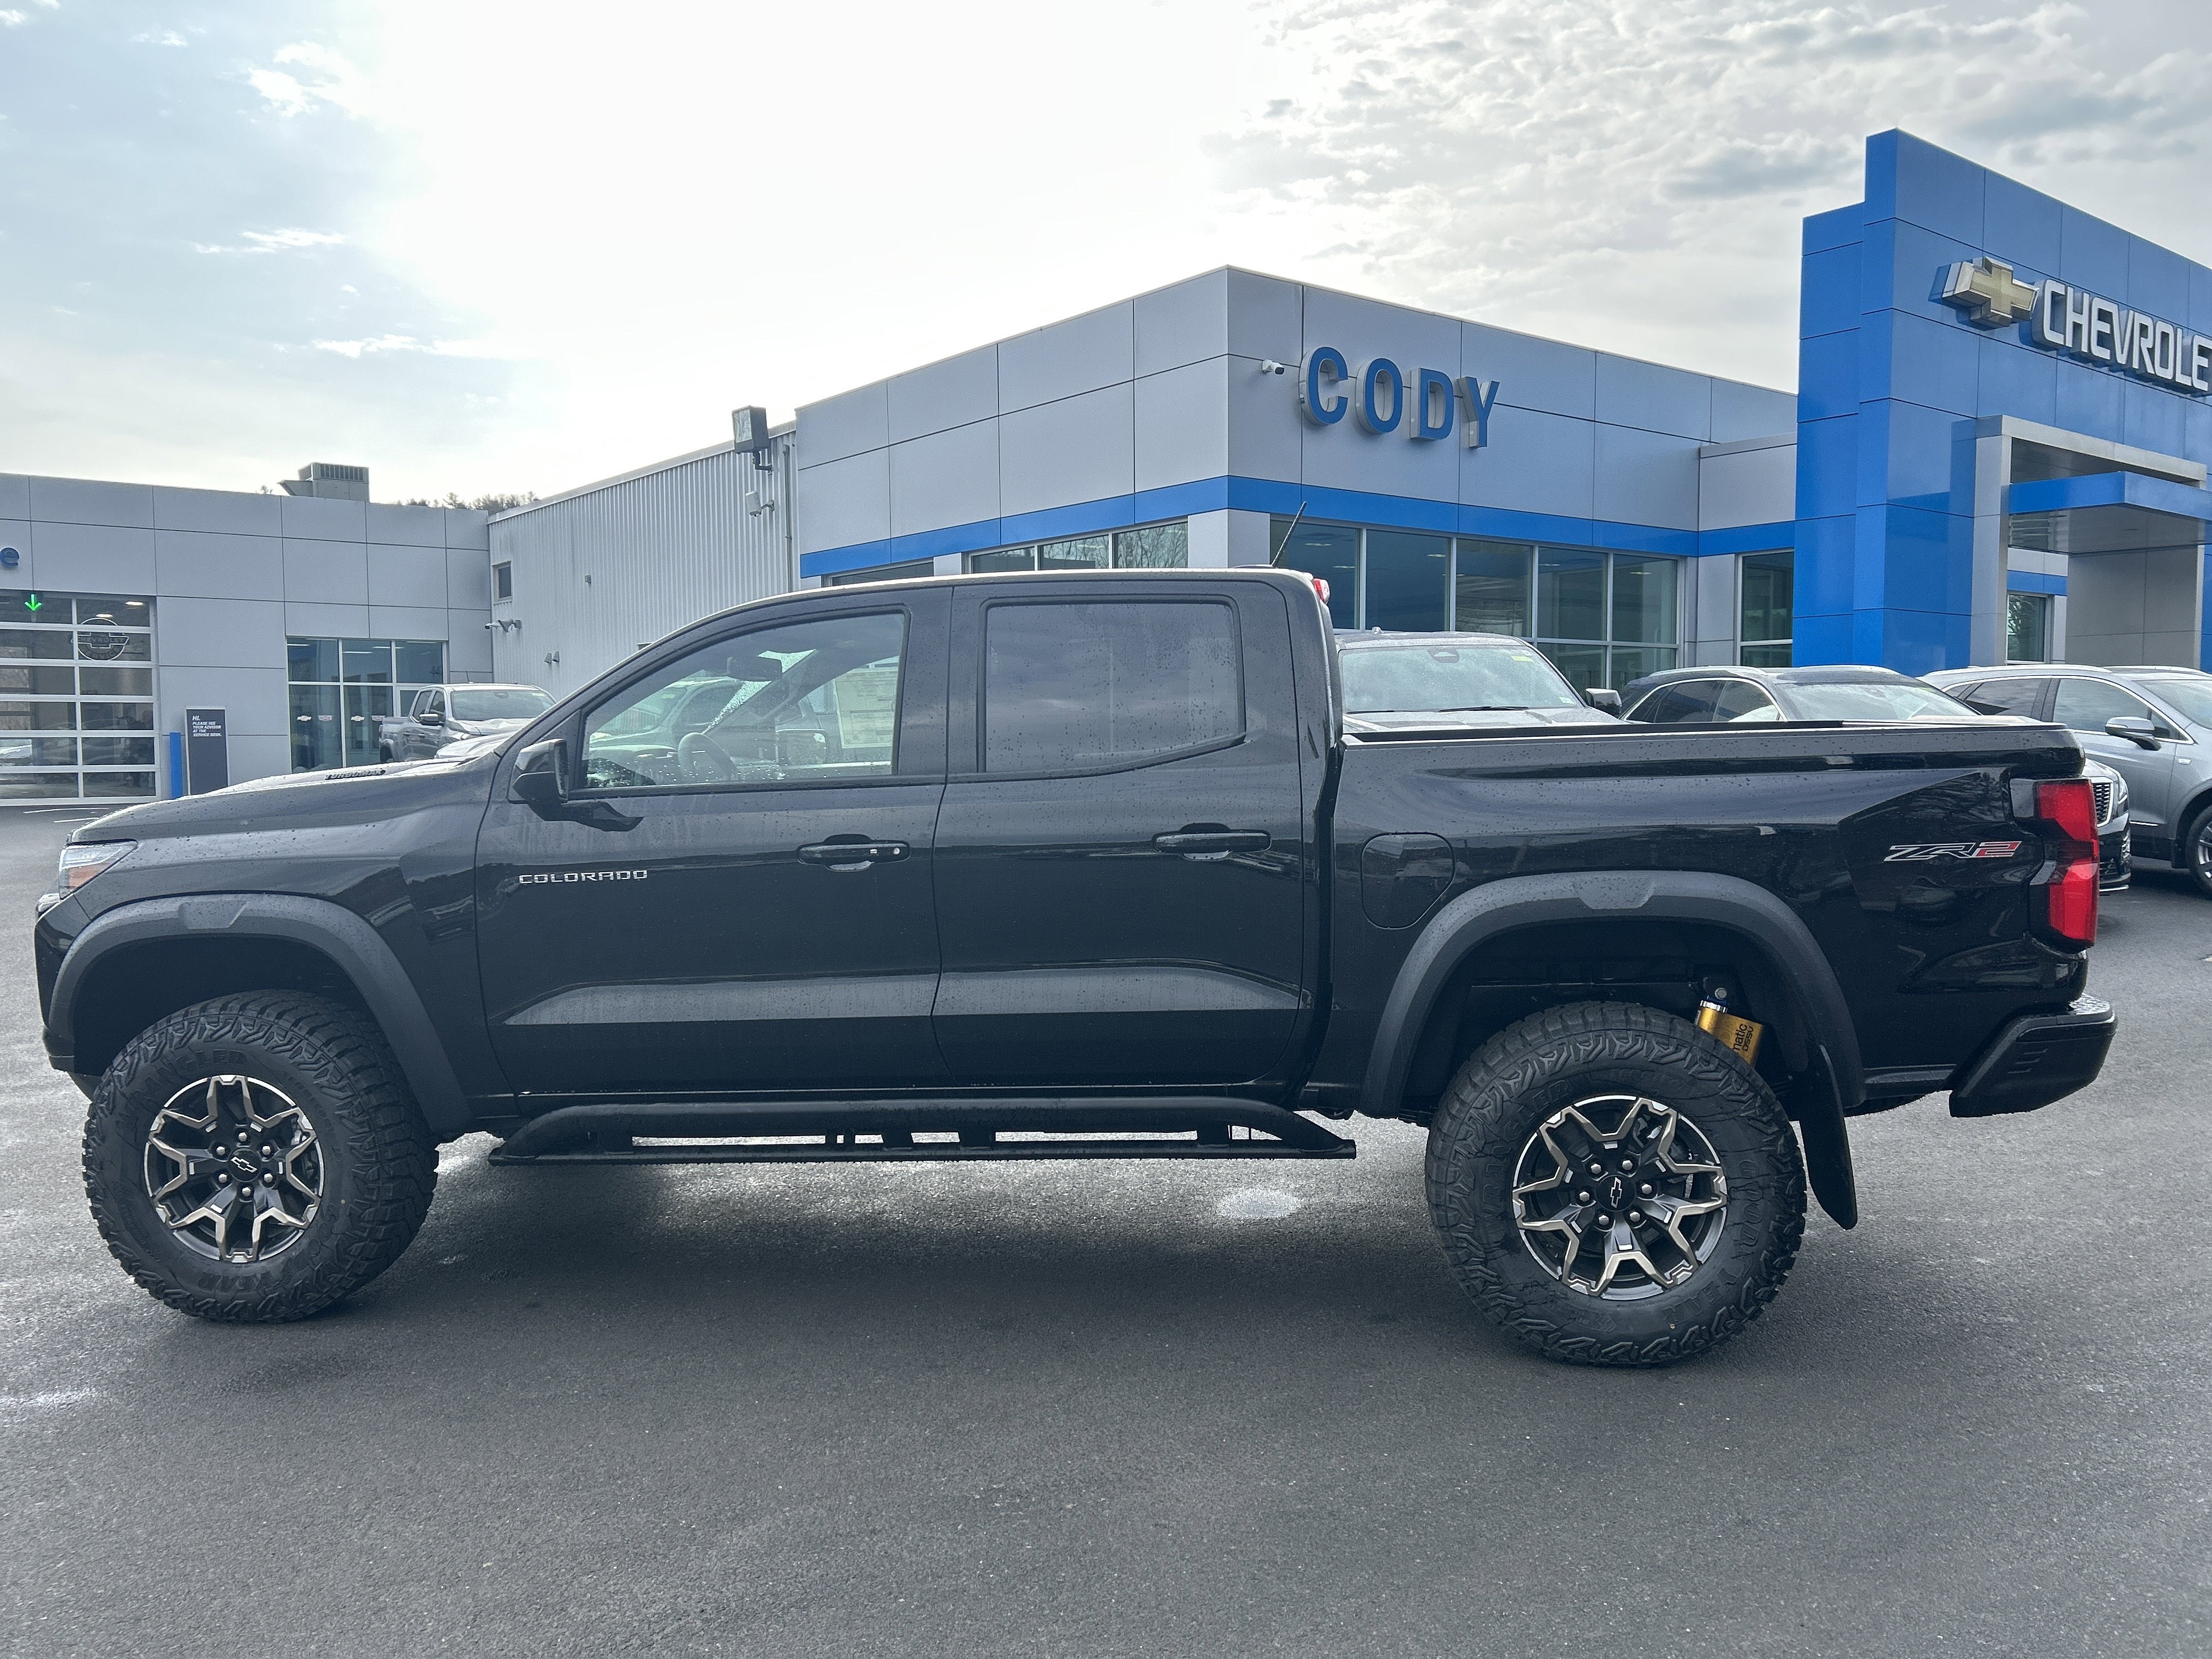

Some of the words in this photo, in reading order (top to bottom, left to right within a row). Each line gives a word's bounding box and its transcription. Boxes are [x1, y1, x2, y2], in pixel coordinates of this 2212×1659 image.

[1300, 347, 1500, 448] CODY
[1884, 840, 2022, 861] ZR2
[519, 870, 647, 884] COLORADO
